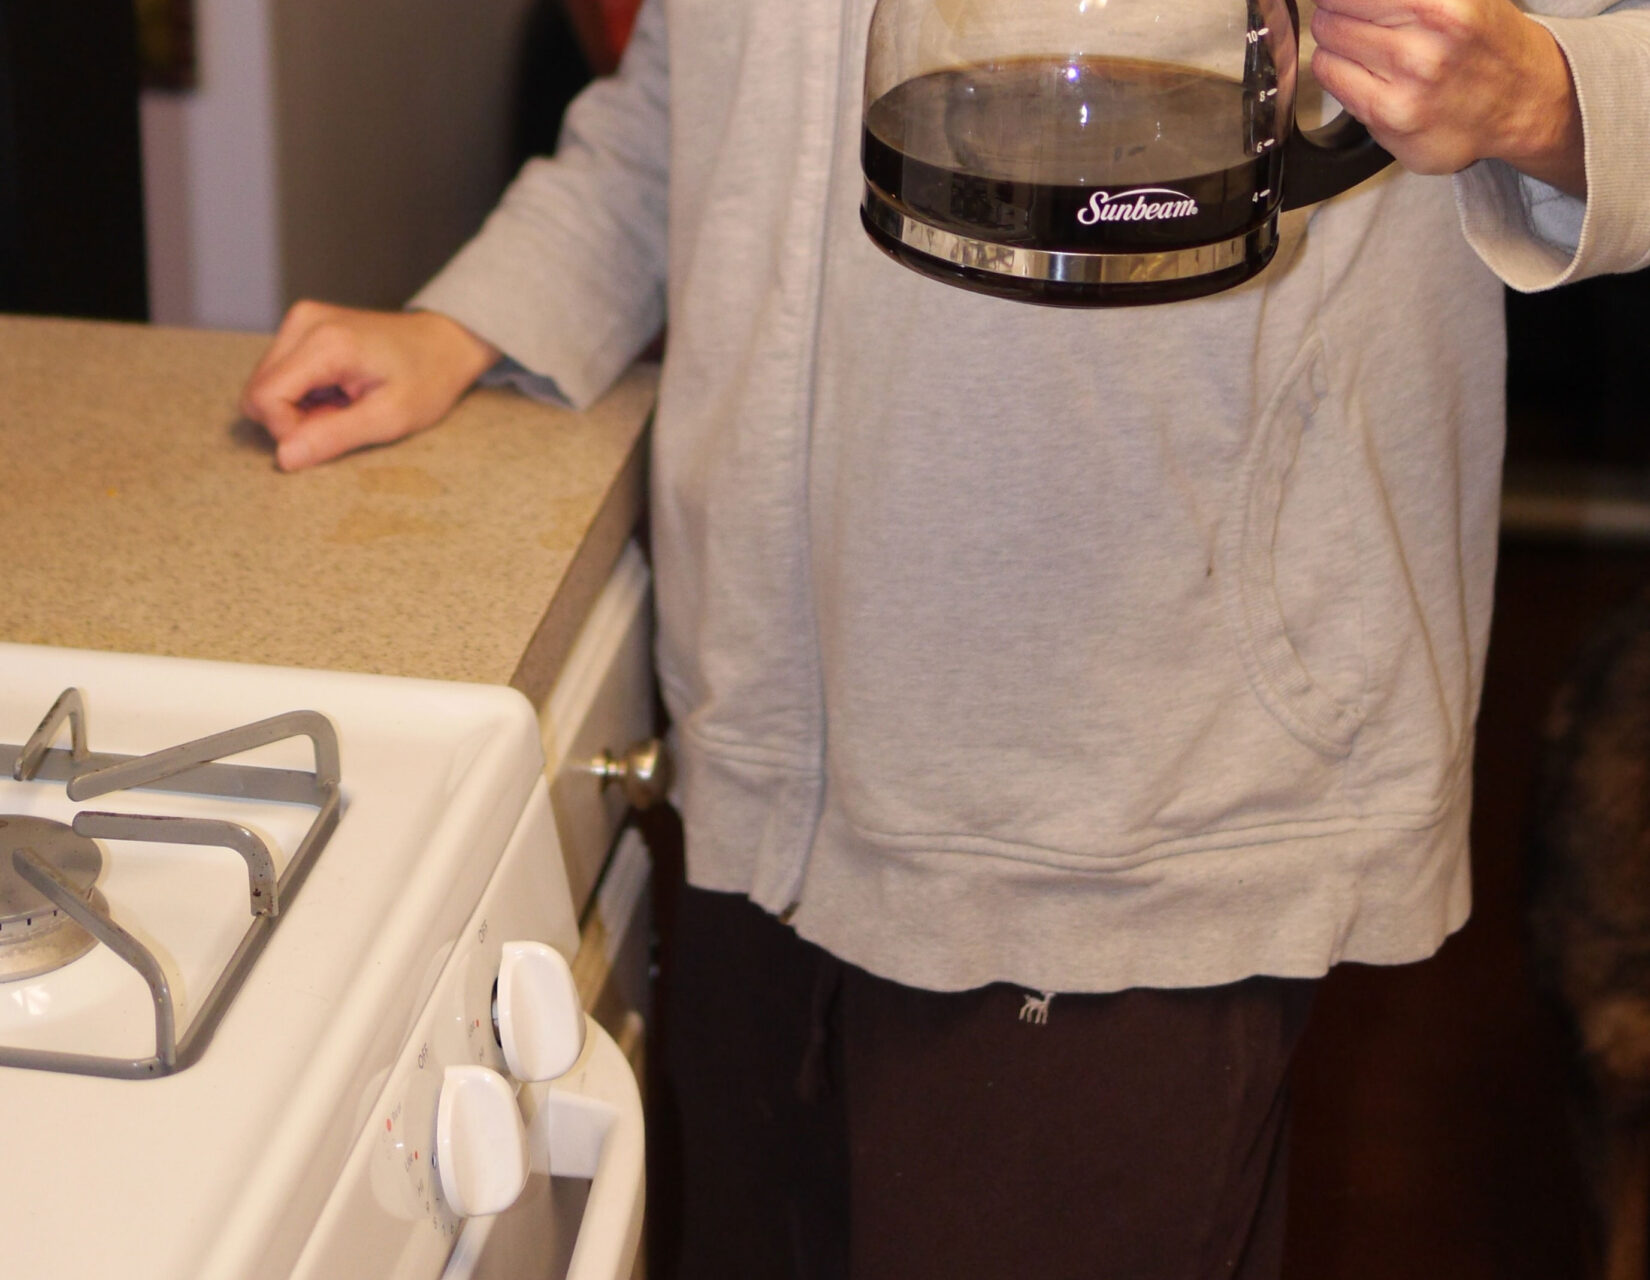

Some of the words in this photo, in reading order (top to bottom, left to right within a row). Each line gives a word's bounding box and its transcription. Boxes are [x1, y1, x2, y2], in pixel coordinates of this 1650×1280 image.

[1246, 30, 1258, 44] 10
[1259, 90, 1266, 102] 8
[1256, 141, 1263, 153] 6
[1252, 192, 1259, 203] 4
[1077, 188, 1196, 225] Sunbeam
[417, 1041, 429, 1069] OFF
